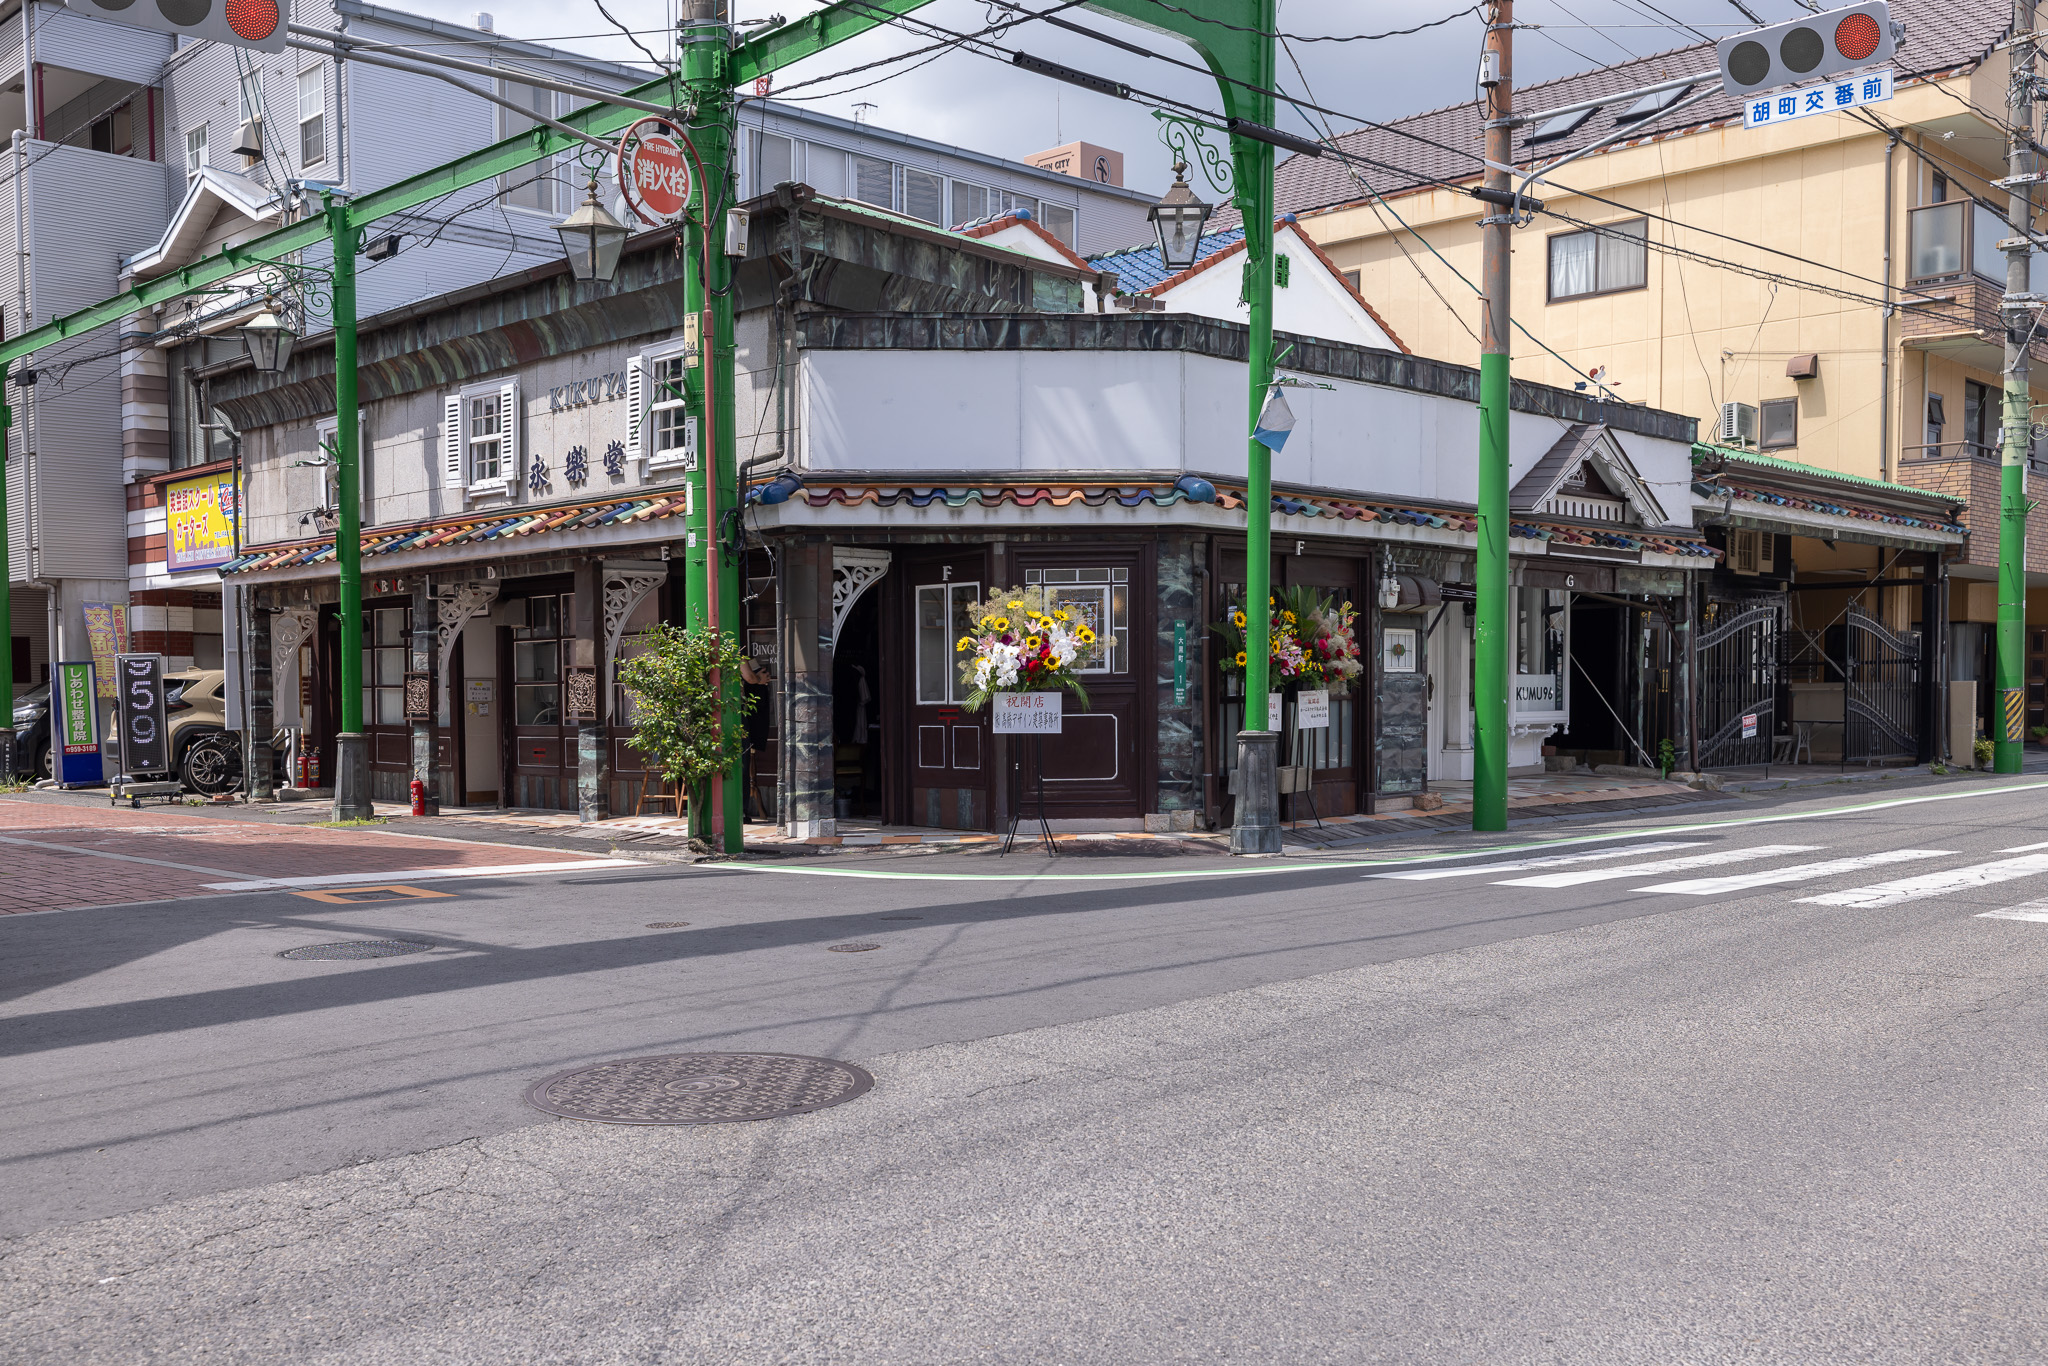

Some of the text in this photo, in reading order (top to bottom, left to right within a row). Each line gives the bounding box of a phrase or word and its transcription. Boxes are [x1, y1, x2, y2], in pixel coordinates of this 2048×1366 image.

[1752, 77, 1882, 123] 胡町交番前
[643, 141, 679, 158] FIRE HYDRANT
[1055, 158, 1071, 170] CITY
[636, 158, 687, 198] 消火栓
[549, 371, 628, 410] KIKUYA
[685, 451, 696, 468] 34
[169, 484, 215, 514] 英会話スクール
[176, 512, 209, 540] カーターズ
[661, 546, 671, 561] E
[1295, 540, 1305, 556] F
[487, 566, 496, 580] D
[942, 565, 953, 581] F
[1565, 574, 1575, 587] G
[381, 579, 405, 593] B C
[303, 588, 310, 601] A
[1516, 686, 1553, 701] KUMU96
[69, 667, 88, 742] しあわせ整骨院
[1006, 695, 1045, 709] 祝開店
